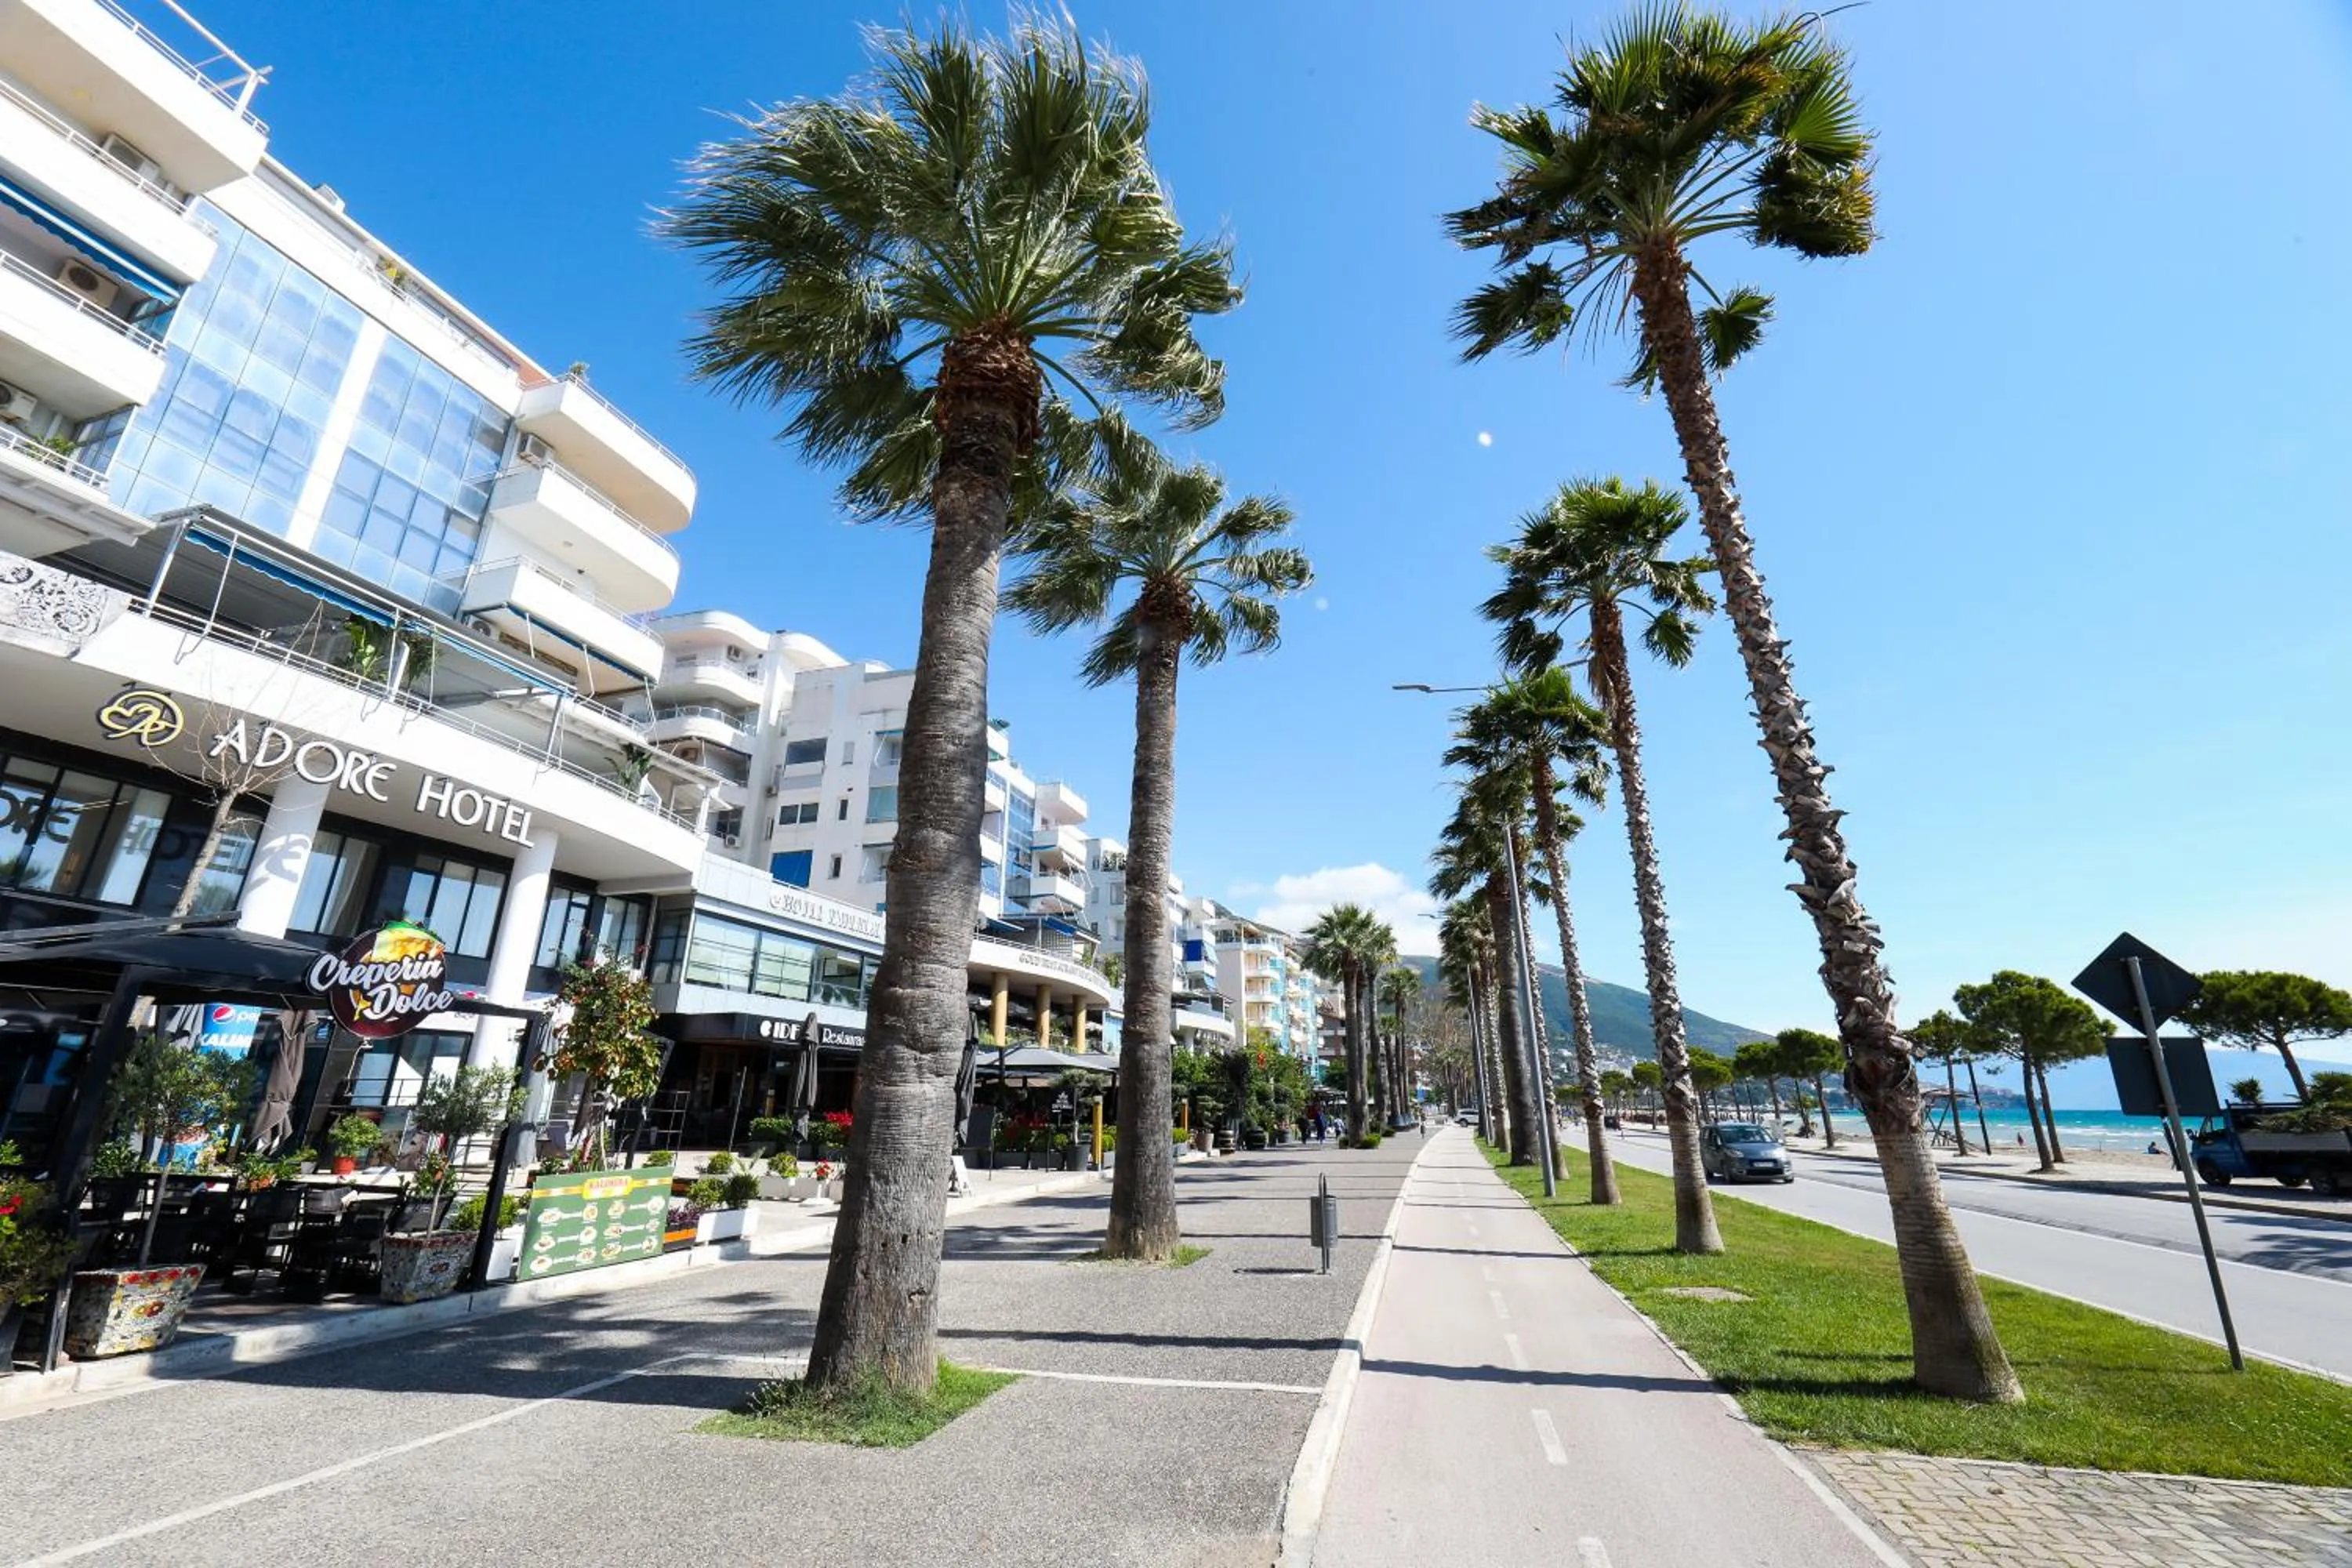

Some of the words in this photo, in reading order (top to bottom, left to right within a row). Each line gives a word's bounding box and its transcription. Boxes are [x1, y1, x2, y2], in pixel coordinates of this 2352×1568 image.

[209, 718, 396, 803] ADORE
[416, 774, 535, 849] HOTEL
[310, 953, 444, 991] Creperia
[364, 982, 454, 1020] Dolce
